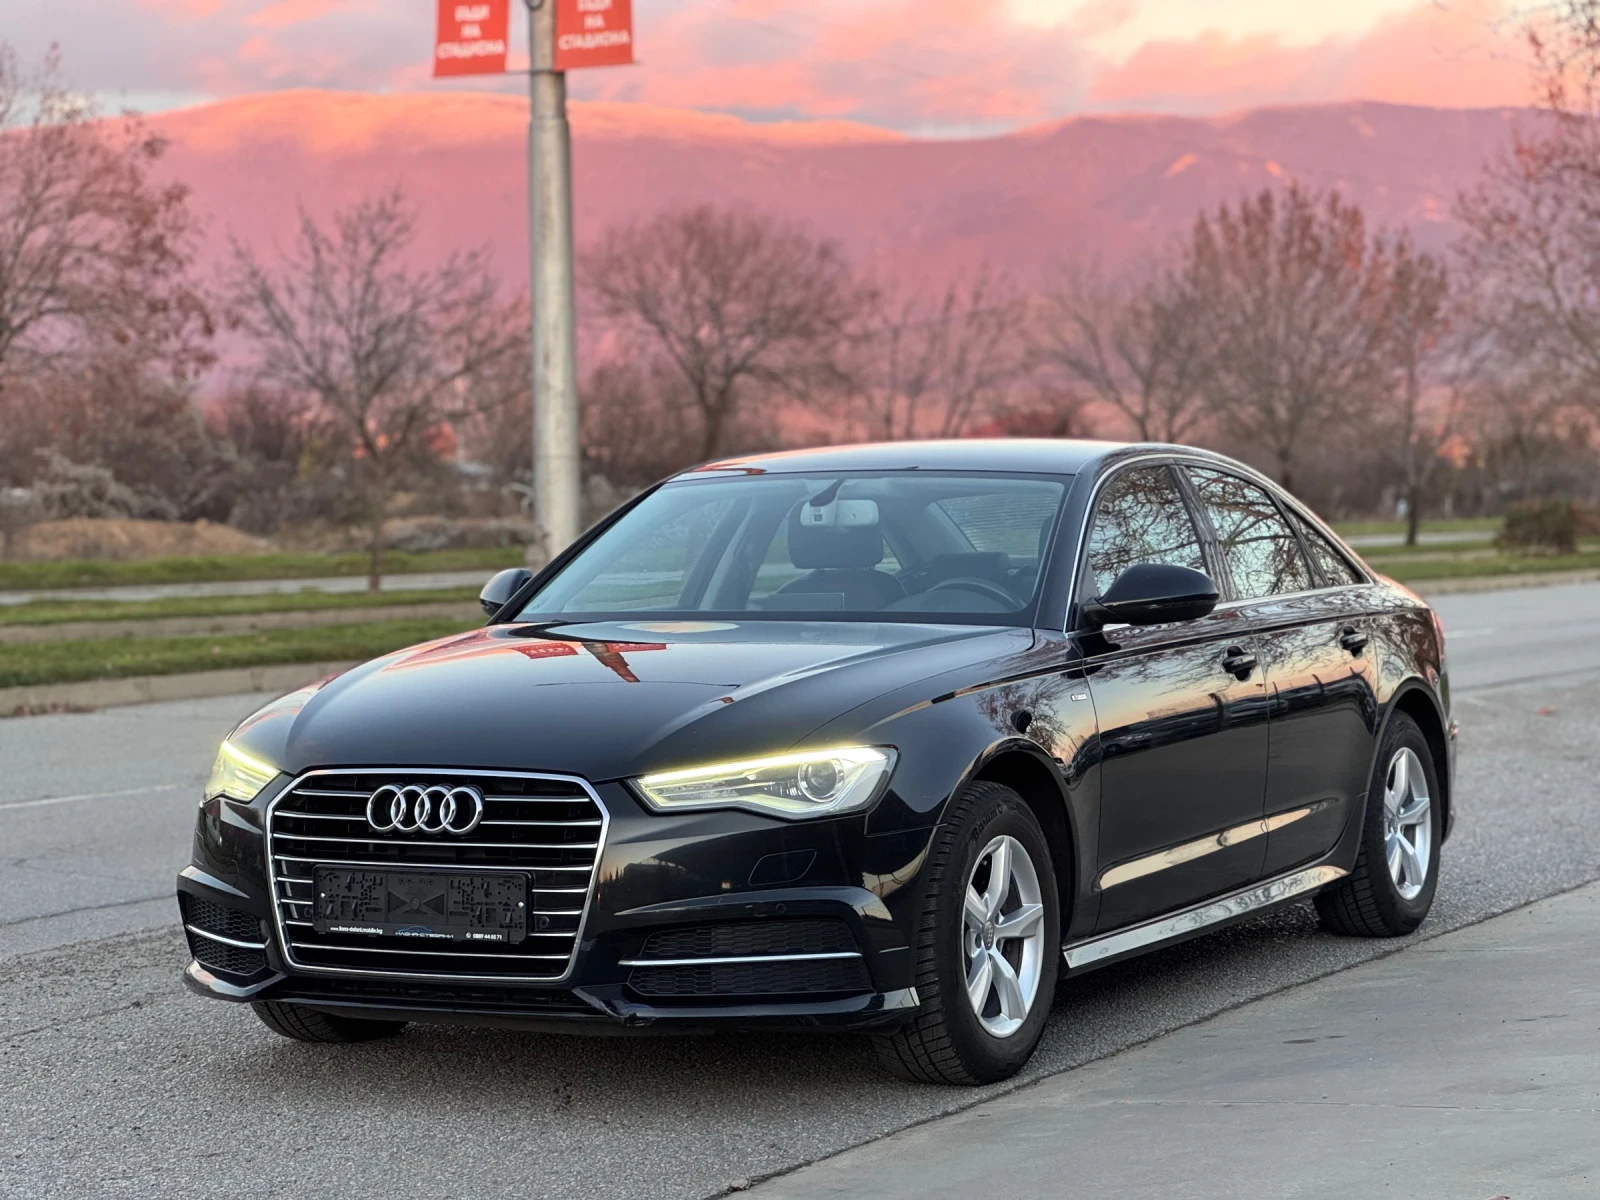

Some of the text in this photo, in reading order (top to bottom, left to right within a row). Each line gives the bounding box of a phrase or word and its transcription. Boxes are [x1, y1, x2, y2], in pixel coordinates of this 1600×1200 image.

[460, 23, 482, 39] НА
[584, 13, 606, 30] НА
[436, 39, 506, 60] СТАДИОНА
[557, 29, 631, 51] СТАДИОНА
